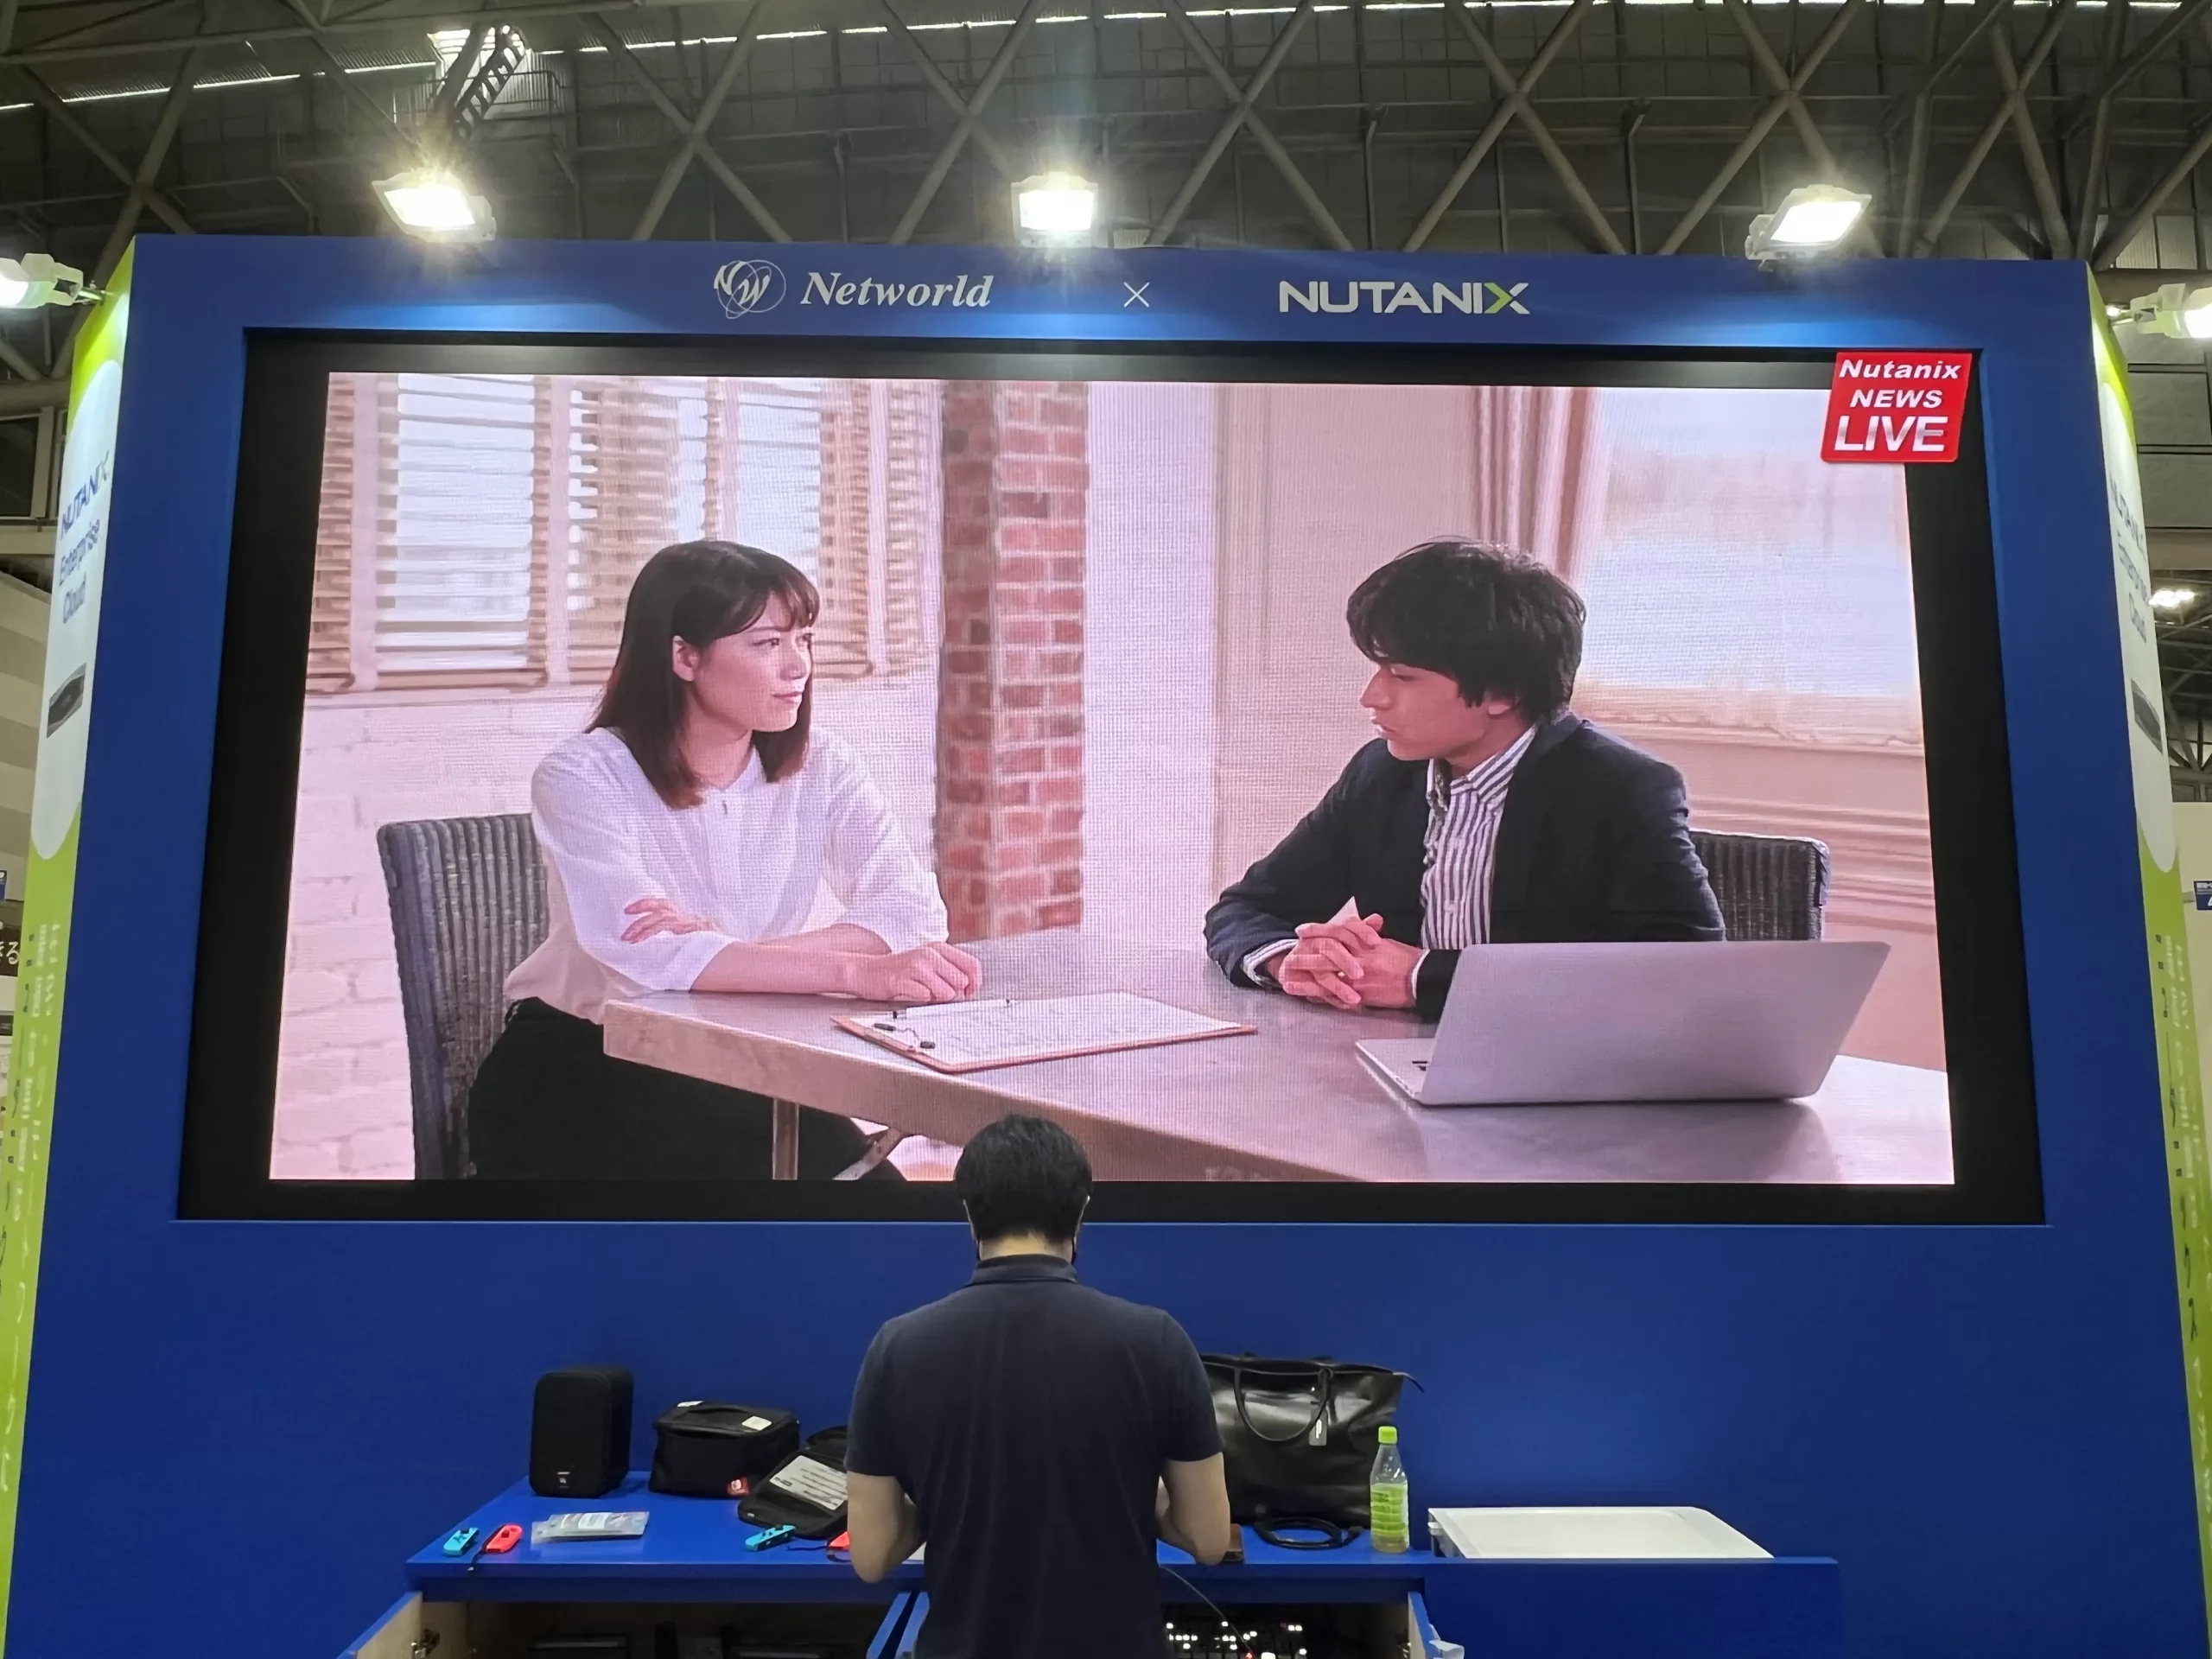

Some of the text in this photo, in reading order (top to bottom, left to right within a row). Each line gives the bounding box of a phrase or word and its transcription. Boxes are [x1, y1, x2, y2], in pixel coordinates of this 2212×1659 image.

[800, 271, 995, 308] Networld
[1279, 280, 1530, 315] NUTANIX
[1839, 359, 1961, 379] Nutanix
[1849, 389, 1943, 409] NEWS
[1834, 416, 1948, 452] LIVE
